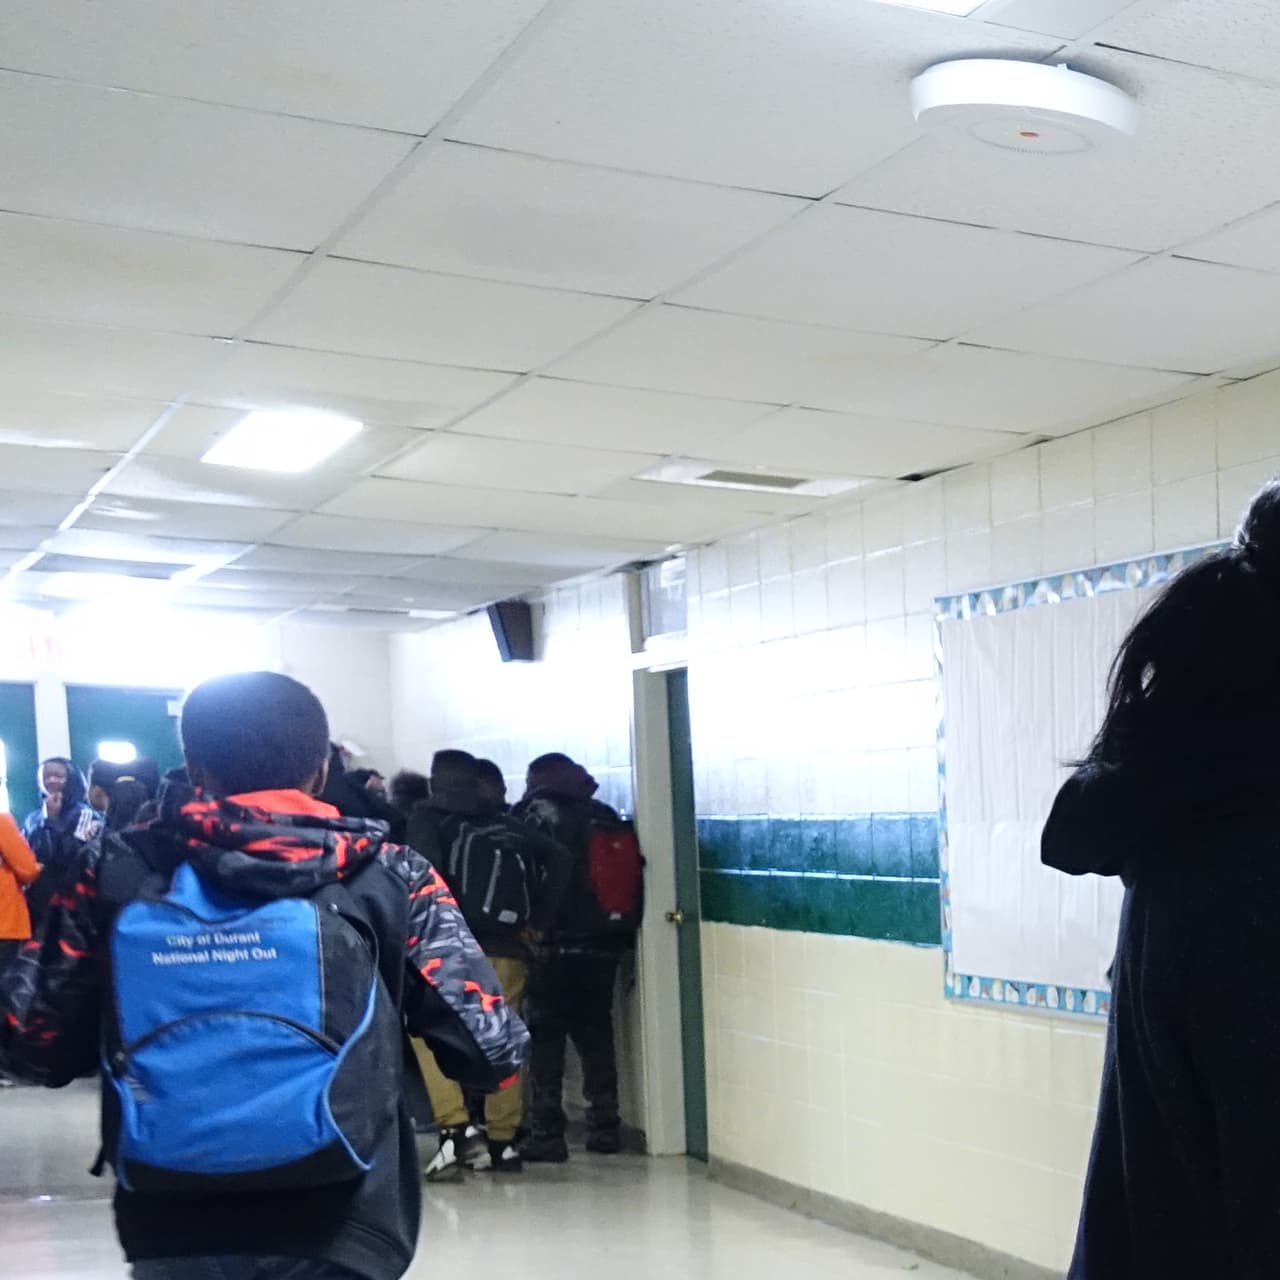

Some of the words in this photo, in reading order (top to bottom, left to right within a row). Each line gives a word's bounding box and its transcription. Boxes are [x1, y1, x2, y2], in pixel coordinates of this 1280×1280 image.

[166, 934, 193, 949] City
[196, 932, 211, 946] of
[214, 930, 262, 945] Durant
[152, 950, 209, 966] National
[212, 948, 249, 964] Night
[251, 946, 277, 961] Out
